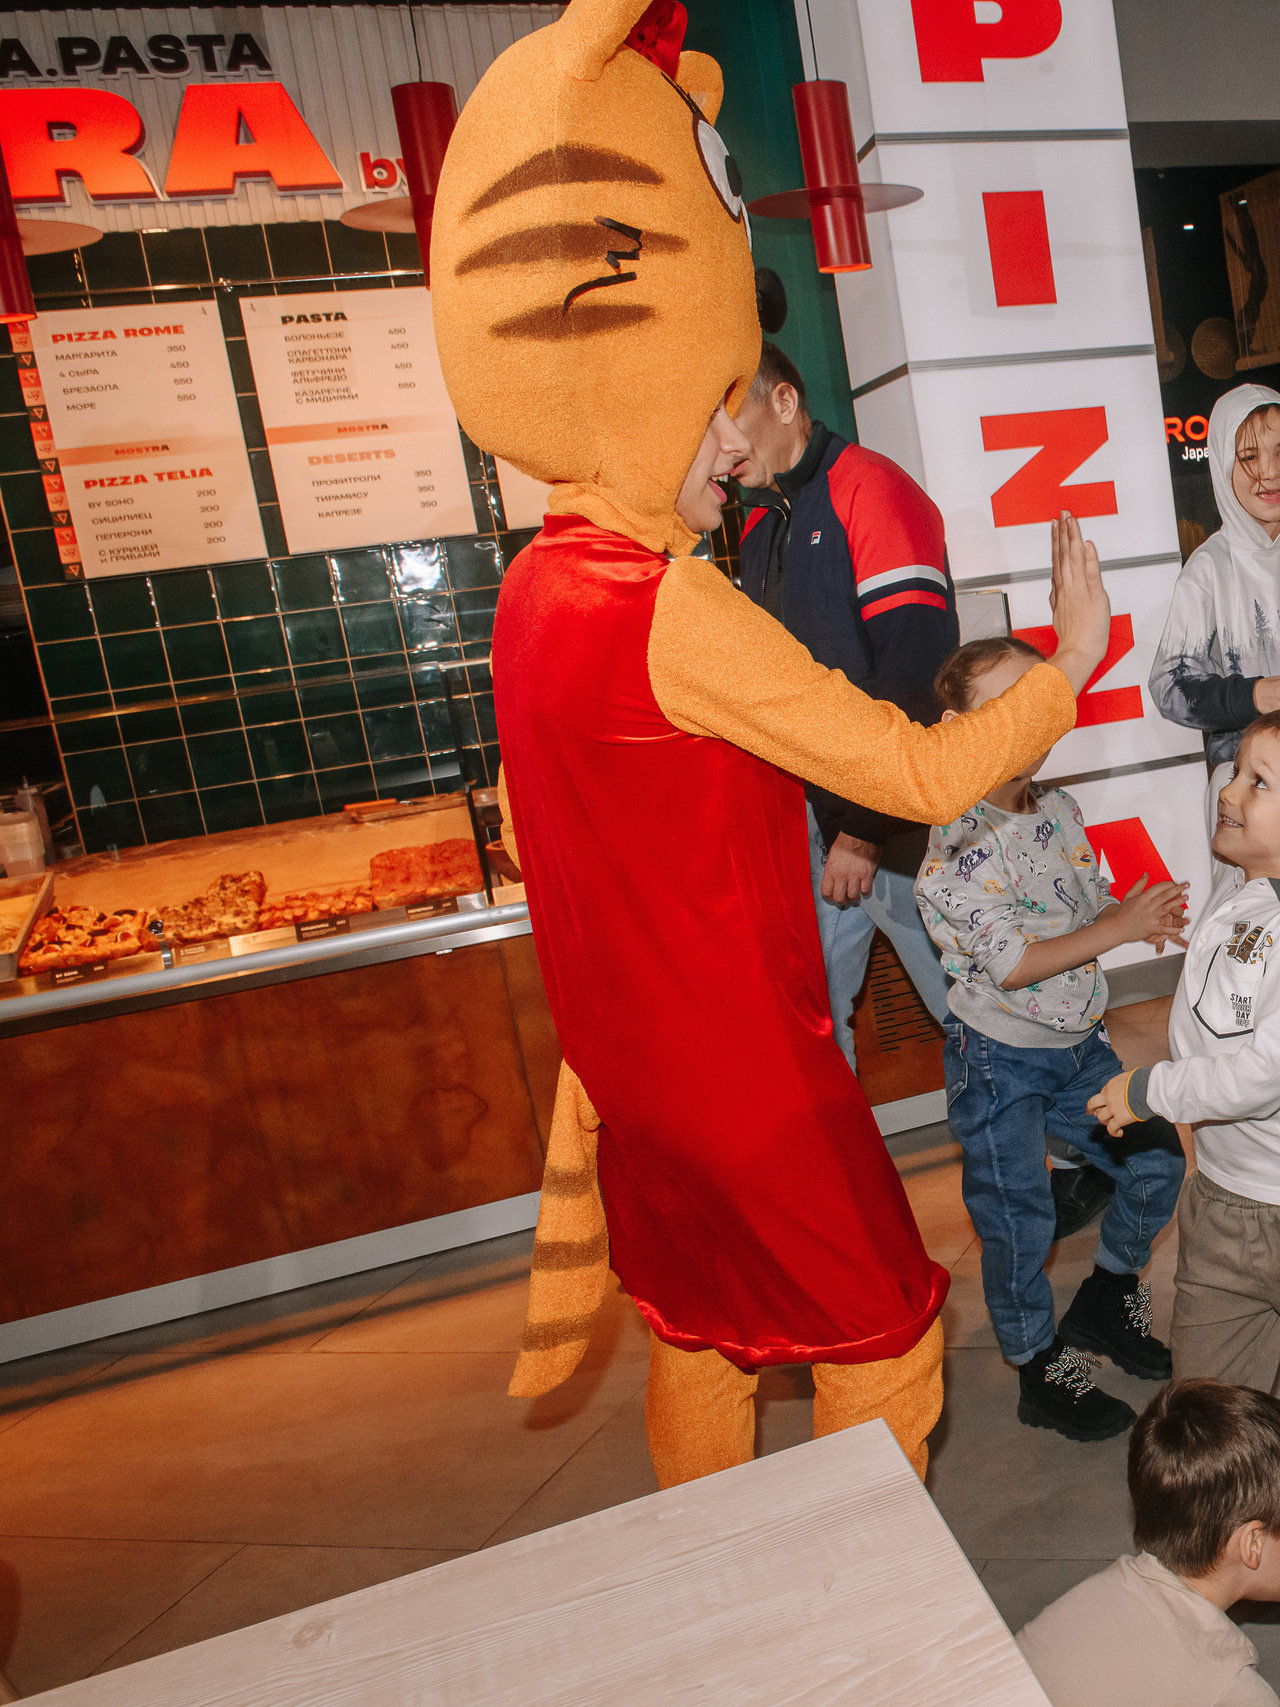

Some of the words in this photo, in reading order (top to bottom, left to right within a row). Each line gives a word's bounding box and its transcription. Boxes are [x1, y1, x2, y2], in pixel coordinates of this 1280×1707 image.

[281, 312, 348, 325] PASTA
[51, 330, 117, 344] PIZZA
[124, 325, 186, 339] ROME
[284, 331, 345, 342] БОЛОНЬЕЗЕ
[388, 327, 406, 336] 450
[55, 350, 118, 362] МАРГАРИТА
[167, 345, 186, 353] 350
[286, 345, 352, 357] СПАГЕТТОНИ
[391, 342, 409, 350] 450
[288, 353, 348, 364] КАРБОНАРА
[68, 368, 100, 378] СЫРА
[170, 361, 190, 369] 450
[291, 367, 345, 378] ФЕТУЧИНИ
[394, 362, 412, 370] 450
[62, 383, 120, 396] БРЕЗАОЛА
[173, 377, 193, 385] 550
[292, 374, 348, 384] АЛЬФРЕДО
[294, 387, 351, 398] КАЗАРЕЧЧЕ
[398, 382, 416, 390] 550
[66, 403, 97, 412] МОРЕ
[176, 394, 196, 402] 550
[306, 393, 359, 404] МИДИЯМИ
[337, 423, 389, 434] MOSTRA
[114, 444, 170, 456] MOSTRA
[308, 449, 396, 466] DESERTS
[83, 474, 149, 489] PIZZA
[153, 467, 214, 482] TELIA
[311, 474, 381, 487] ПРОФИТРОЛИ
[414, 469, 432, 477] 350
[88, 500, 103, 509] BY
[104, 498, 134, 508] SOHO
[196, 489, 216, 497] 200
[315, 491, 368, 503] ТИРАМИСУ
[417, 485, 435, 493] 350
[91, 512, 153, 525] СИЦИЛИЕЦ
[200, 504, 220, 513] 200
[318, 508, 363, 519] КАПРЕЗЕ
[420, 500, 438, 509] 350
[95, 529, 153, 541] ПЕПЕРОНИ
[203, 520, 223, 529] 200
[109, 543, 159, 556] КУРИЦЕЙ
[206, 536, 226, 544] 200
[110, 551, 161, 563] ГРИБАМИ
[1230, 993, 1252, 1004] START
[1235, 1018, 1250, 1027] OFF
[1236, 1011, 1250, 1019] DAY
